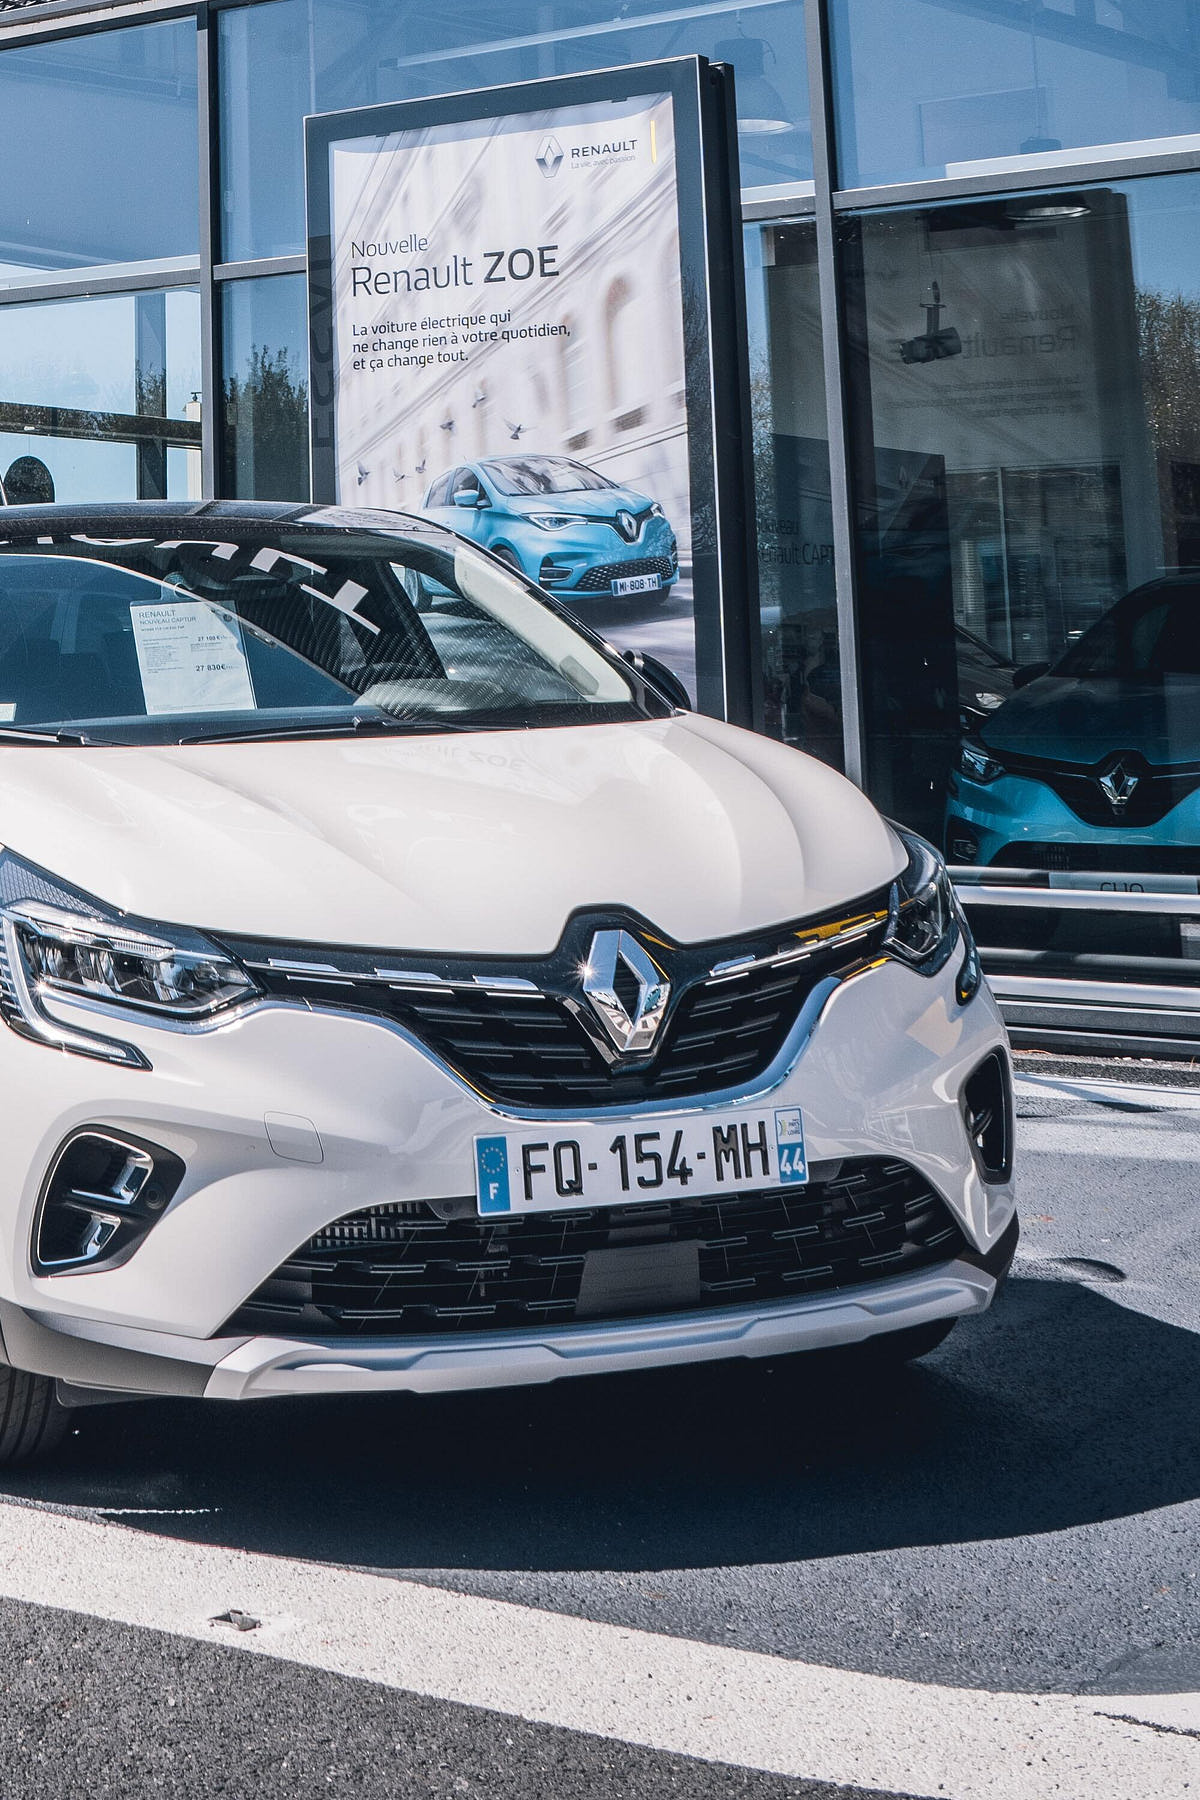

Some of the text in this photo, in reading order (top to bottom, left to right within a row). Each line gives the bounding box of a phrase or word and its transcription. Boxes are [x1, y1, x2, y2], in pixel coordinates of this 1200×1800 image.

[571, 139, 638, 159] RENAULT
[351, 233, 428, 258] Nouvelle
[351, 244, 560, 297] Renault ZOE
[352, 309, 511, 337] La voiture électrique qui
[352, 322, 571, 354] ne change rien à votre quotidien,
[353, 350, 469, 373] et ça change tout.
[139, 609, 176, 619] RENAULT
[140, 616, 197, 626] NOUVEAU CAPTUR
[195, 664, 204, 672] 27
[521, 1120, 770, 1201] FQ-154-MH
[780, 1147, 805, 1175] 44
[488, 1182, 500, 1200] F
